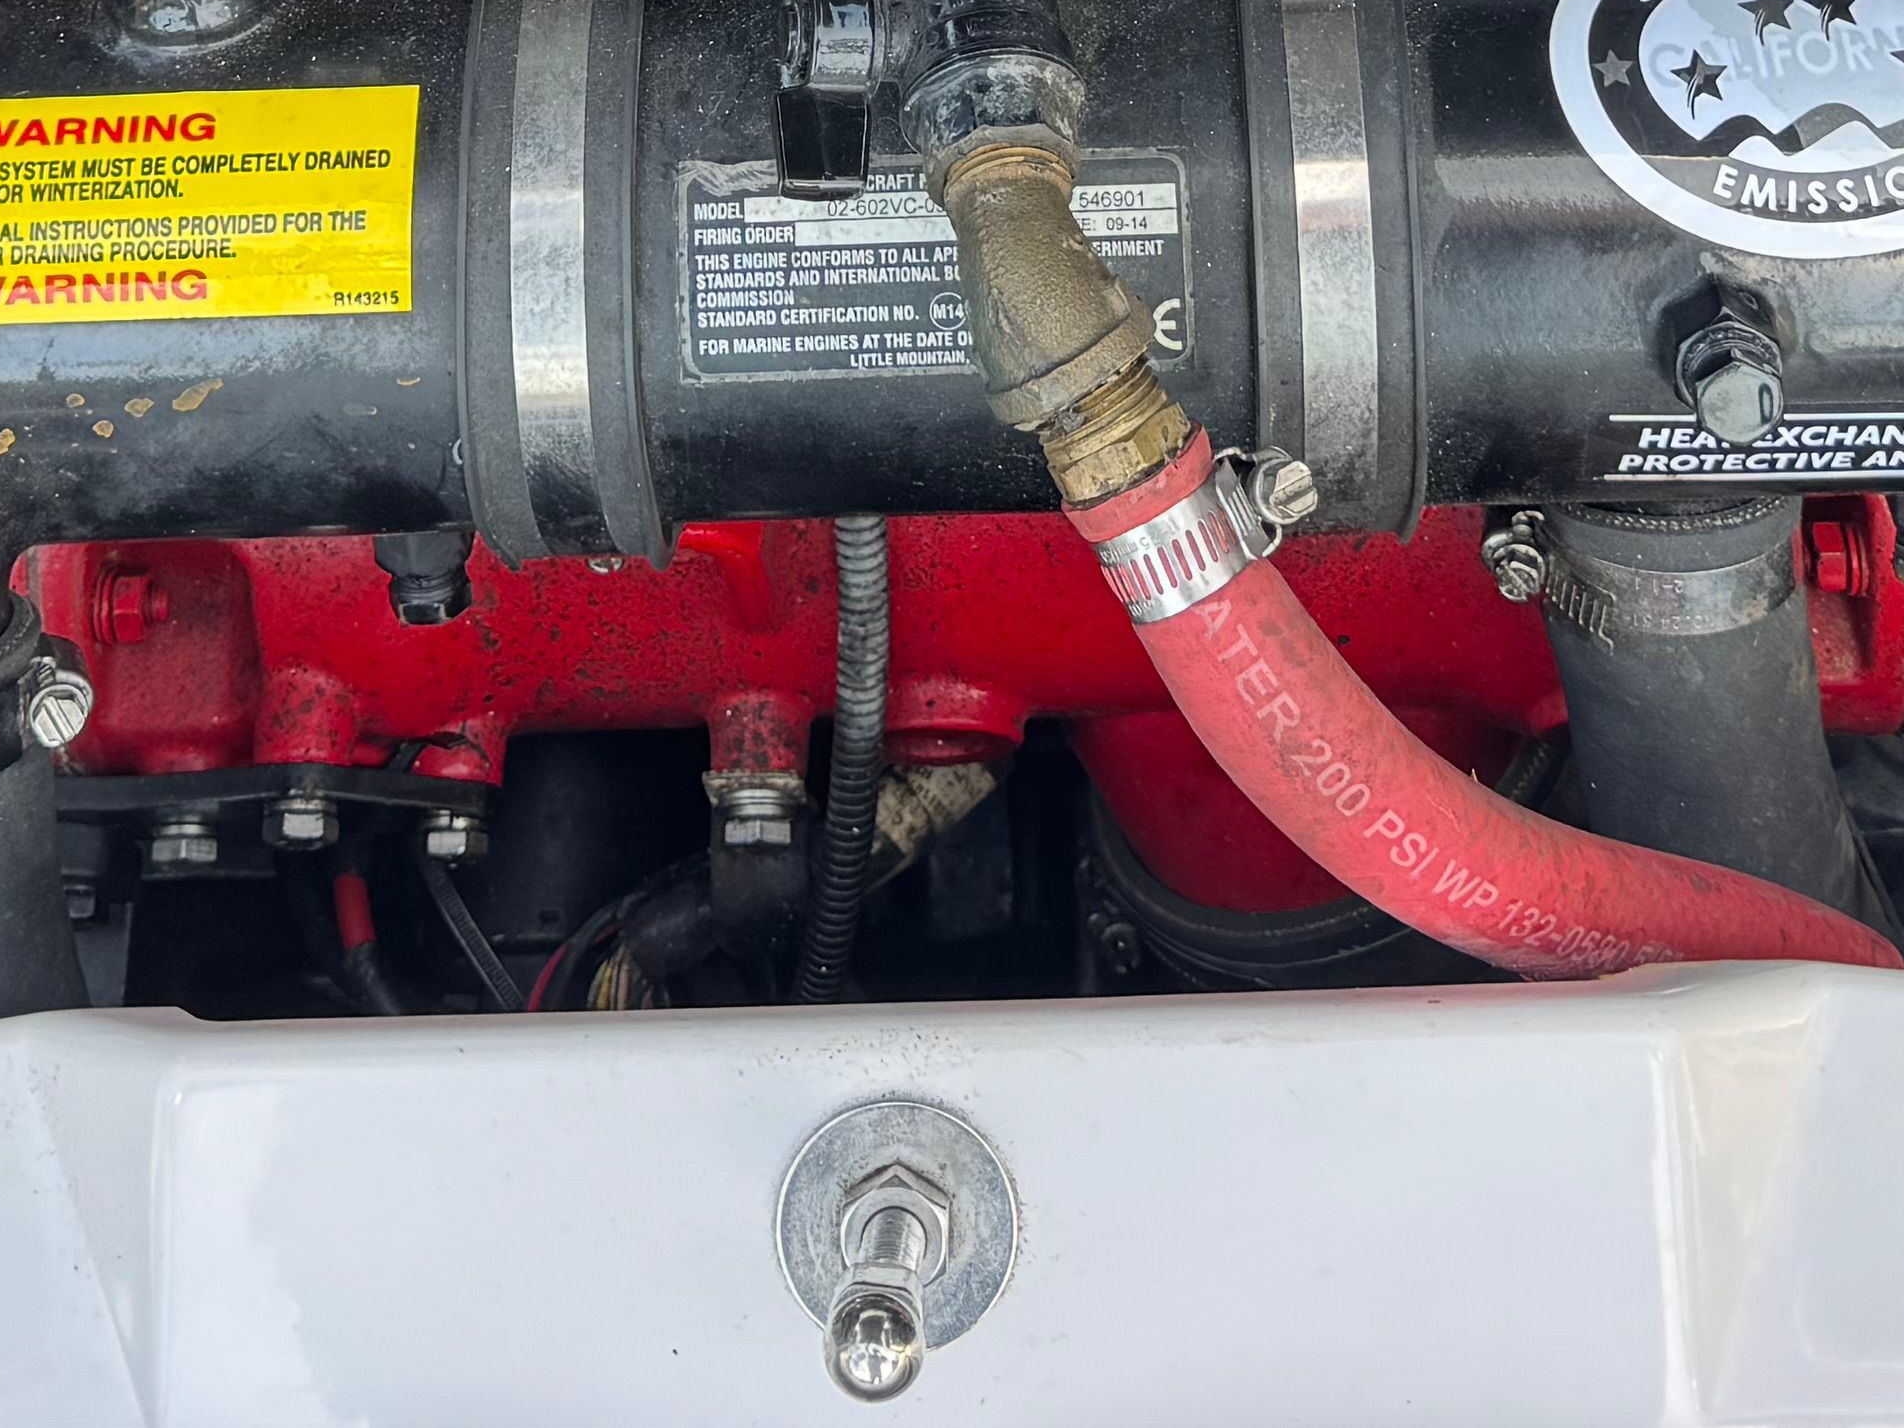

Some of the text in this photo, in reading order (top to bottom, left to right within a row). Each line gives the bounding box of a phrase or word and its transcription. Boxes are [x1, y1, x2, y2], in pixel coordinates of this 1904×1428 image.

[81, 157, 136, 178] MUST
[141, 156, 167, 176] BE
[171, 151, 300, 176] COMPLETELY
[304, 148, 391, 171] DRAINED
[30, 178, 184, 203] WINTERIZATION.
[866, 174, 918, 192] CRAFT
[694, 202, 744, 221] MODEL
[1079, 190, 1145, 208] 546901
[30, 217, 172, 241] INSTRUCTIONS
[178, 213, 277, 236] PROVIDED
[283, 211, 323, 232] FOR
[328, 210, 366, 231] THE
[694, 228, 742, 246] FIRING
[745, 225, 795, 244] ORDER
[1105, 217, 1148, 231] 09-14
[11, 242, 104, 264] DRAINING
[110, 238, 237, 262] PROCEDURE.
[695, 254, 729, 271] THIS
[734, 251, 787, 270] ENGINE
[791, 249, 875, 268] CONFORMS
[879, 248, 897, 264] TO
[902, 247, 929, 264] ALL
[1092, 239, 1165, 256] ERNMENT
[696, 271, 785, 290] STANDARDS
[789, 269, 820, 287] AND
[824, 265, 941, 285] INTERNATIONAL
[333, 291, 400, 306] R143215
[696, 290, 795, 309] COMMISSION
[697, 309, 777, 328] STANDARD
[781, 305, 889, 325] CERTIFICATION
[893, 304, 920, 321] NO.
[699, 339, 729, 355] FOR
[733, 336, 791, 354] MARINE
[795, 334, 859, 352] ENGINES
[863, 334, 881, 349] AT
[883, 333, 913, 349] THE
[916, 332, 953, 347] DATE
[850, 349, 971, 368] LITTLE MOUNTAIN,
[1637, 427, 1732, 450] HEA
[1617, 451, 1856, 472] PROTECTIVE
[1198, 598, 1302, 744] ATER
[1291, 738, 1372, 819] 200
[1362, 807, 1440, 878] PSI
[1431, 858, 1499, 910] WP
